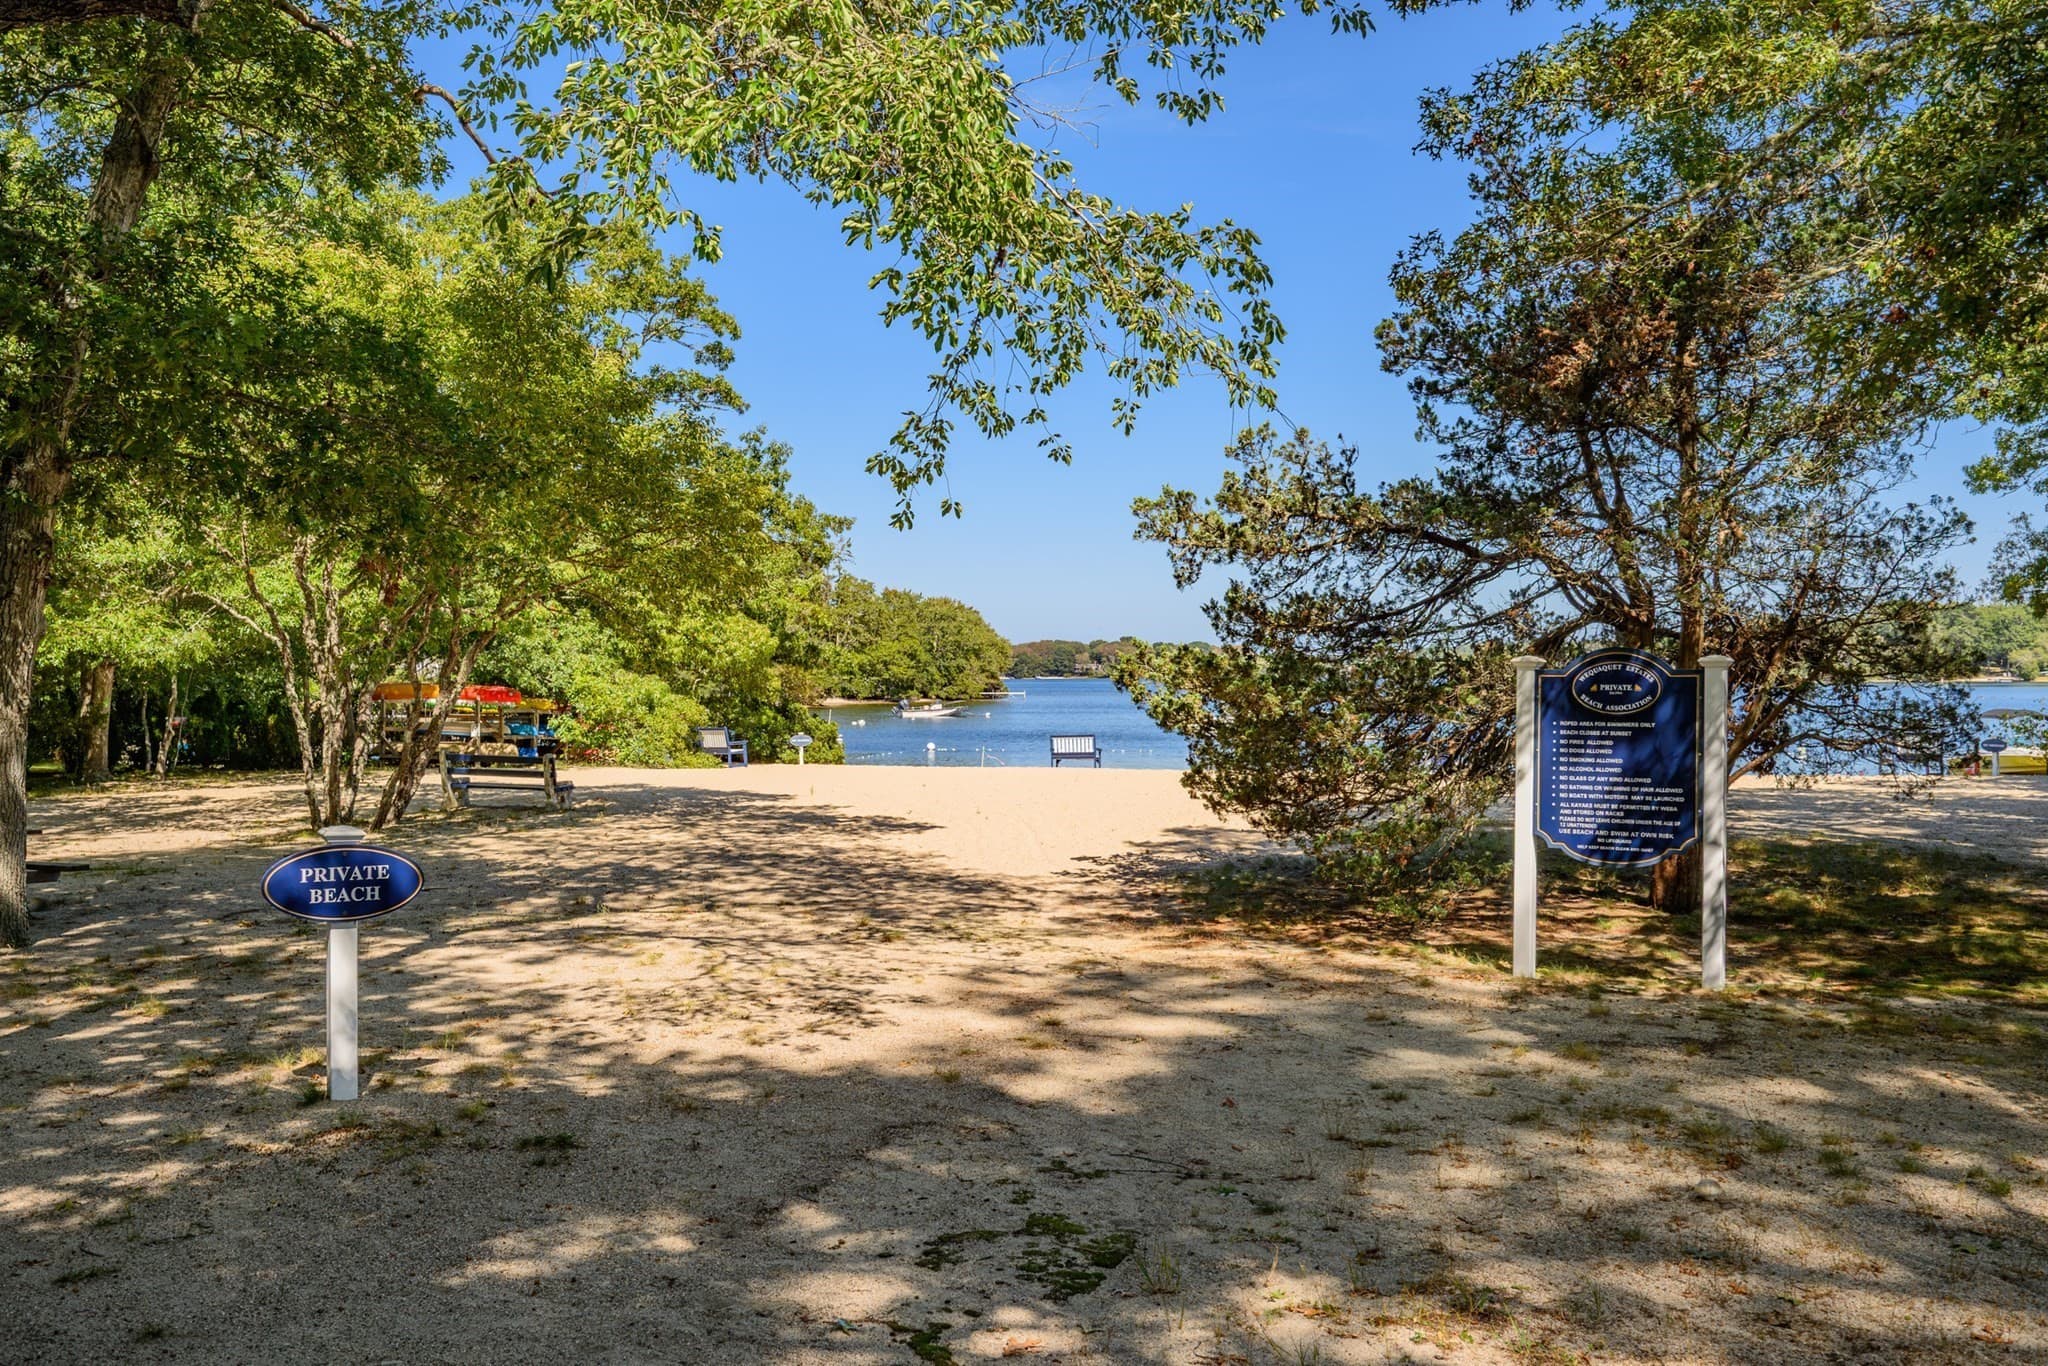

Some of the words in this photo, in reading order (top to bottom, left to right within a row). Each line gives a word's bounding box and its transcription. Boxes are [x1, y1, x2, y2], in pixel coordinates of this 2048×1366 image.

[1579, 664, 1622, 682] WEQUAQUET
[1625, 665, 1655, 683] ESTATES
[1580, 694, 1603, 709] BEACH
[1605, 695, 1653, 711] ASSOCIATION
[300, 864, 390, 883] PRIVATE
[309, 886, 381, 904] BEACH
